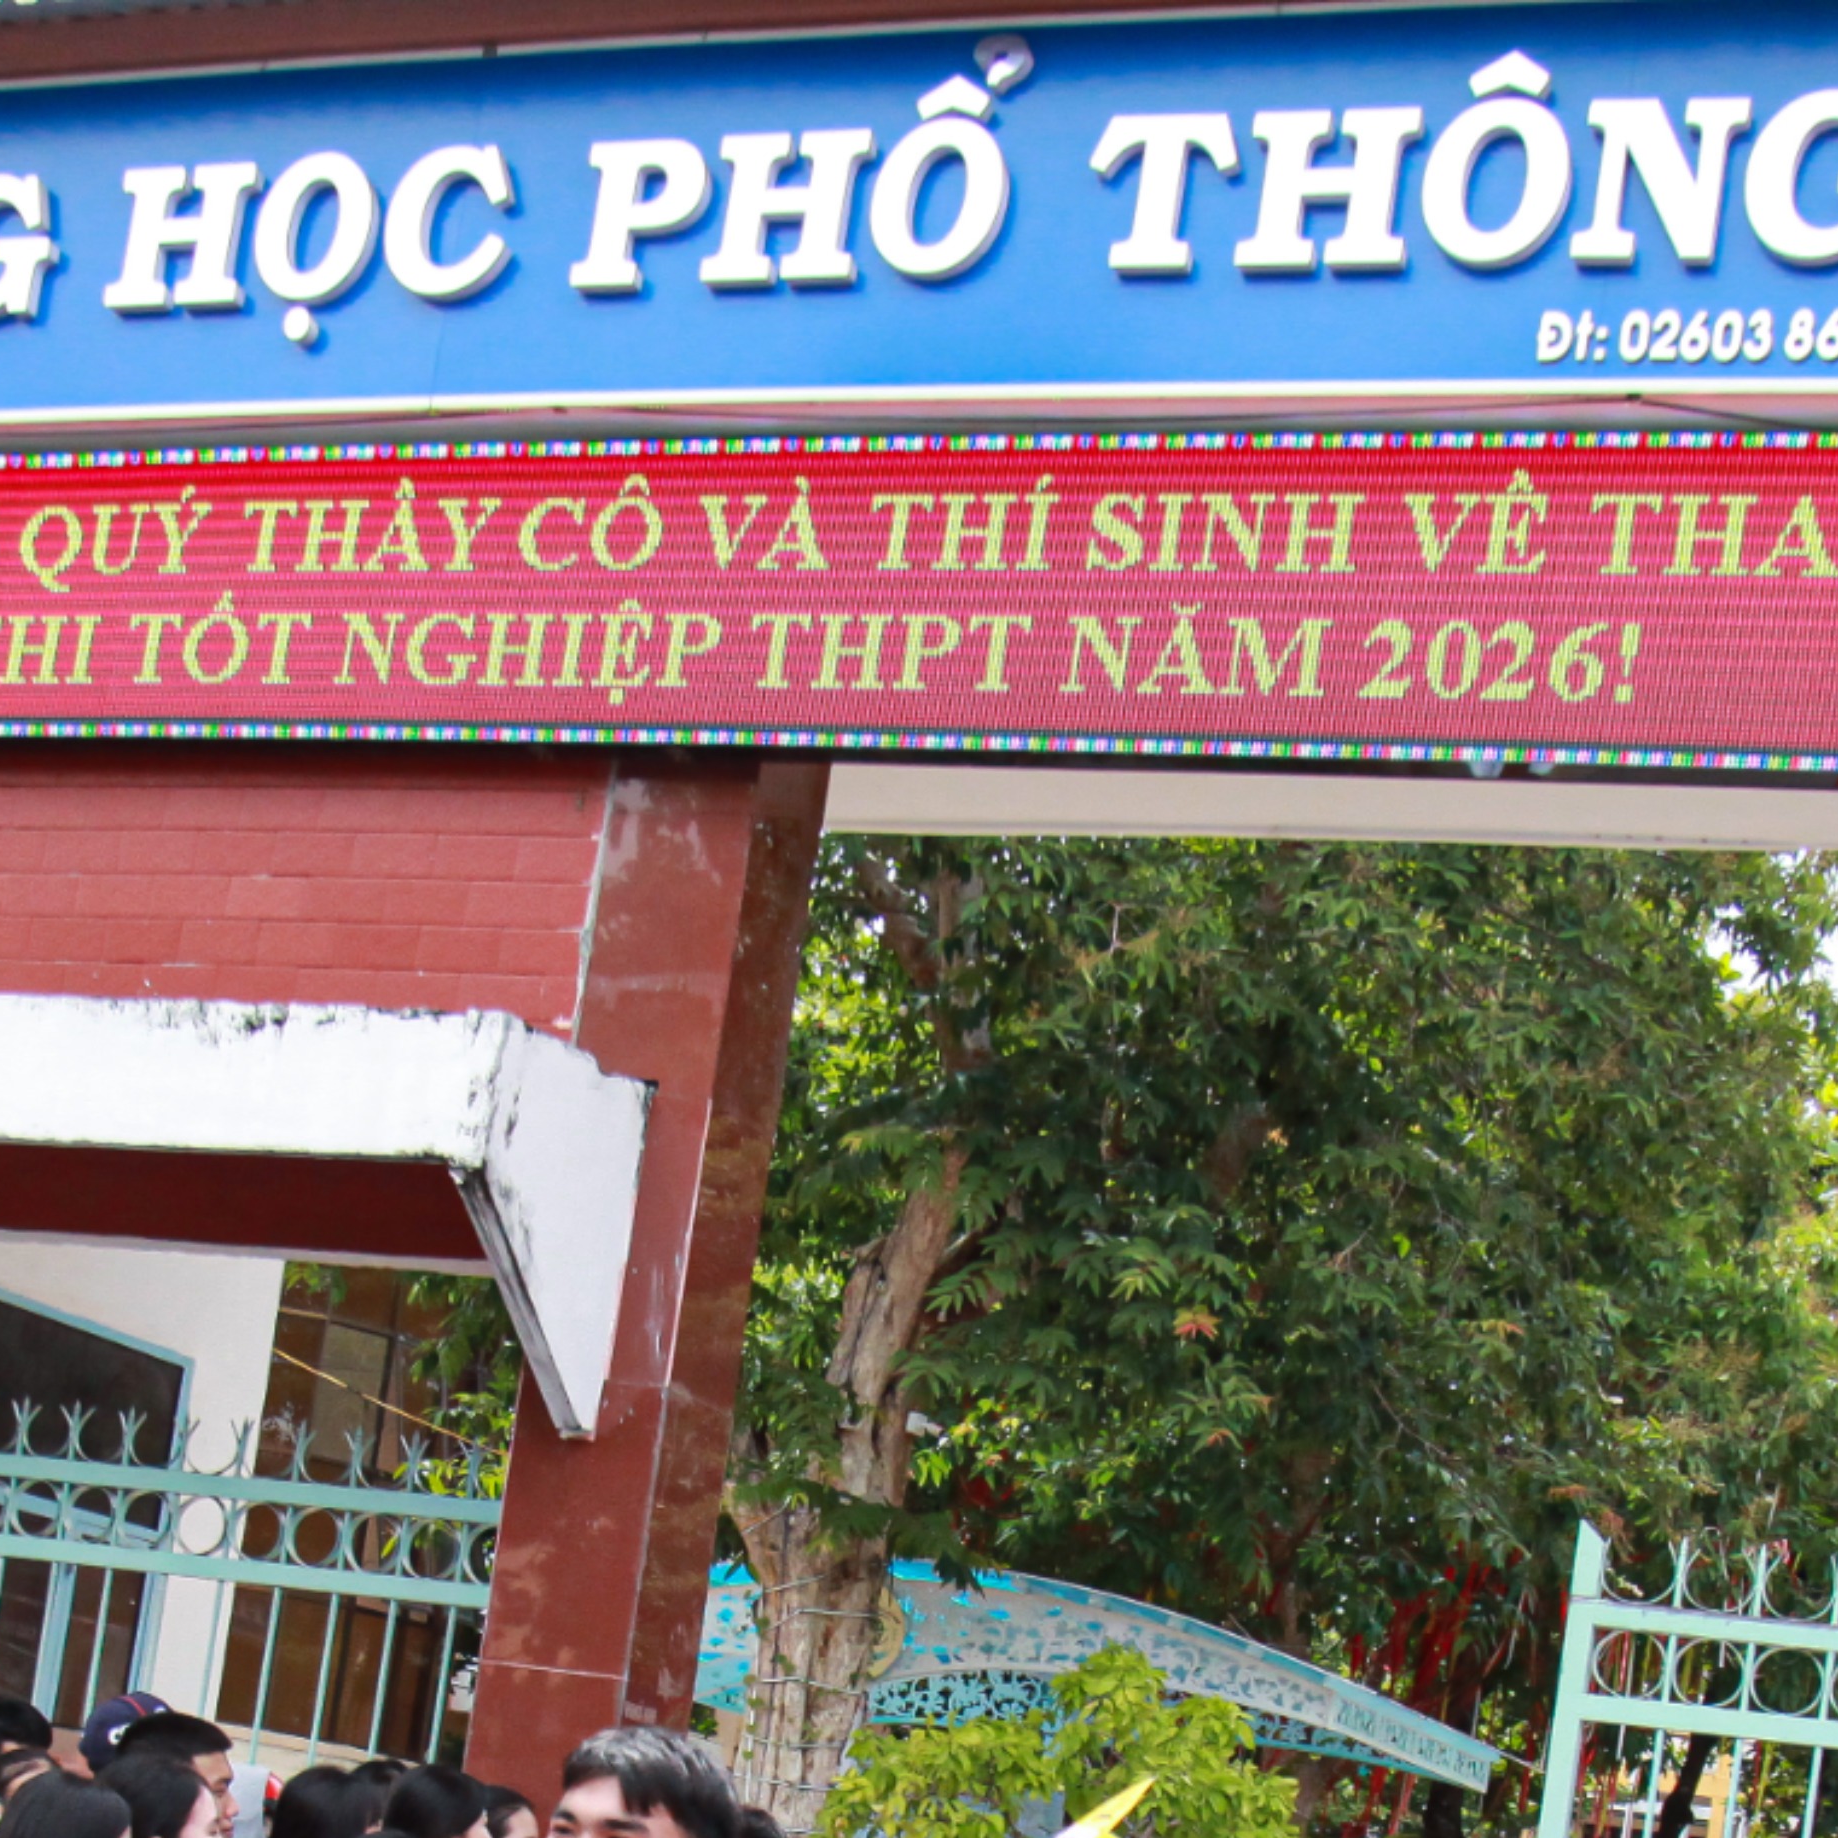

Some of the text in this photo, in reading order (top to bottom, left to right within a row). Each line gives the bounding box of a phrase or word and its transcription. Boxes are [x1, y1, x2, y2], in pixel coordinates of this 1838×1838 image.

[103, 143, 515, 346] HỌC
[569, 34, 1034, 294] PHỔ
[1537, 309, 1608, 361] Đt:
[1619, 307, 1774, 361] 02603
[17, 484, 212, 593] QUÝ
[516, 473, 664, 571] CÔ
[699, 475, 830, 571] VÀ
[871, 474, 1055, 571] THÍ
[1084, 492, 1368, 574] SINH
[130, 589, 313, 685] TỐT
[334, 599, 722, 705] NGHIỆP
[752, 613, 1033, 691] THPT
[1058, 602, 1332, 697] NĂM
[1358, 618, 1641, 703] 2026!
